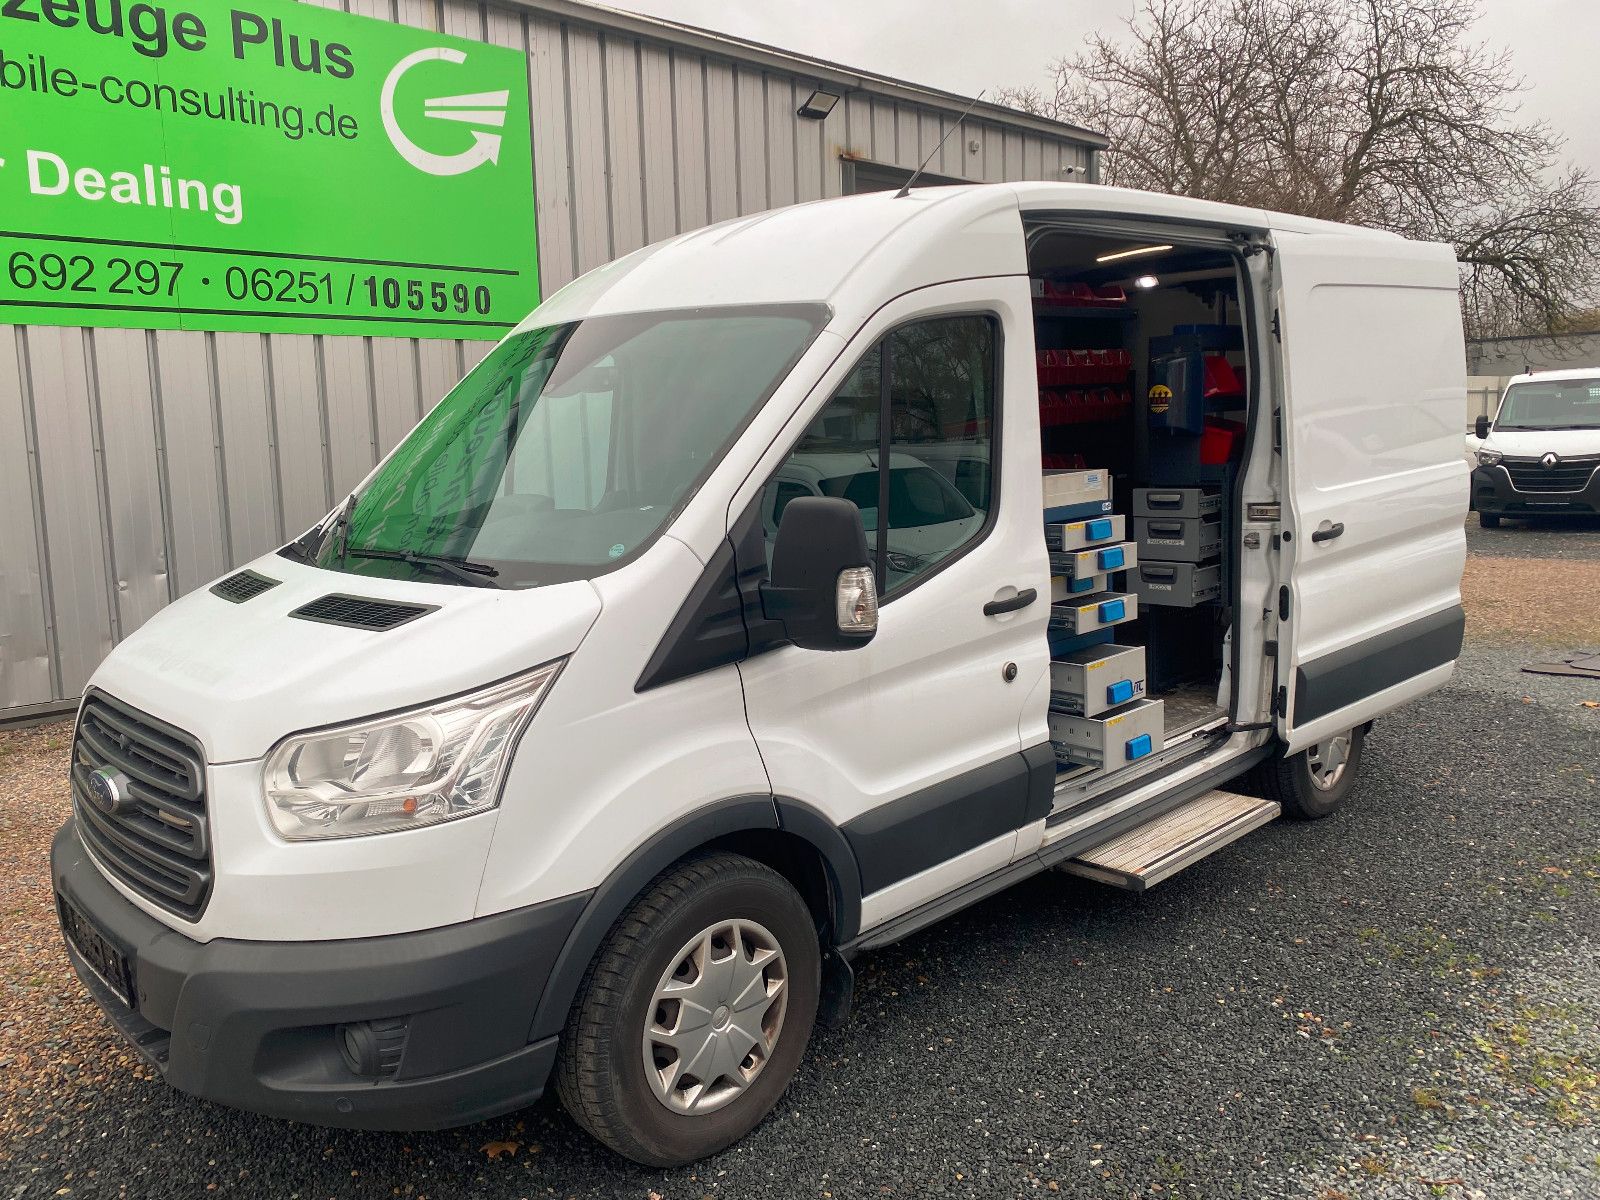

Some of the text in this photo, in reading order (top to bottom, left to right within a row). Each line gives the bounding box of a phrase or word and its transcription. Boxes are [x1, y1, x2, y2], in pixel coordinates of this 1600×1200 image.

[230, 9, 355, 79] Plus
[0, 50, 359, 140] bile-consulting.de
[27, 149, 243, 225] Dealing
[8, 251, 97, 291] 692
[107, 257, 184, 296] 297
[225, 266, 333, 304] 06251
[363, 275, 492, 315] 105590
